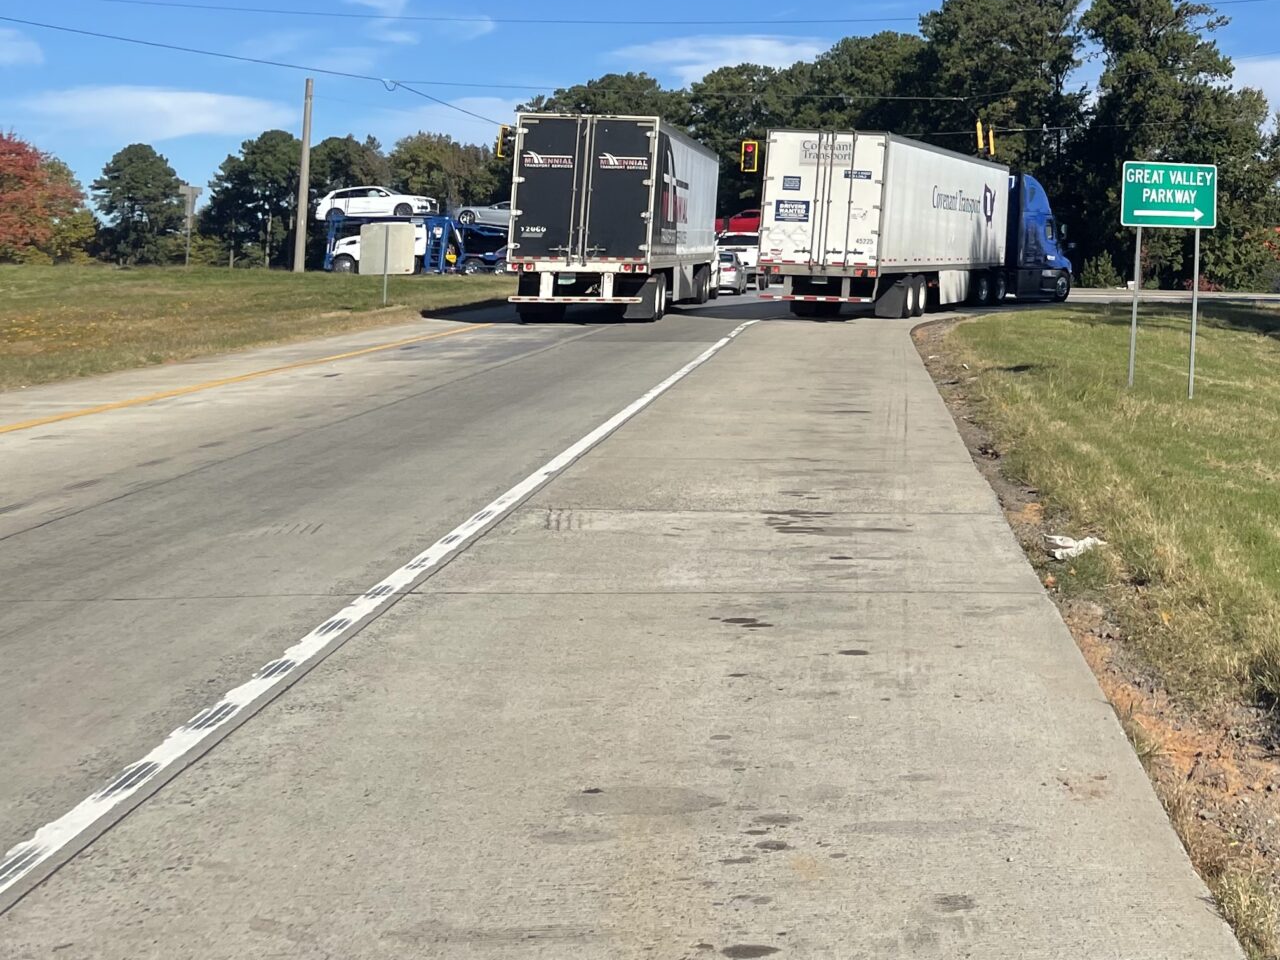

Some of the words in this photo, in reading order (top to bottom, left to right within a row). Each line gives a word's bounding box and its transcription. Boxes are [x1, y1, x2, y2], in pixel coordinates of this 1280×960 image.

[1126, 168, 1165, 184] GREAT
[1169, 170, 1213, 186] VALLEY
[1142, 188, 1197, 203] PARKWAY
